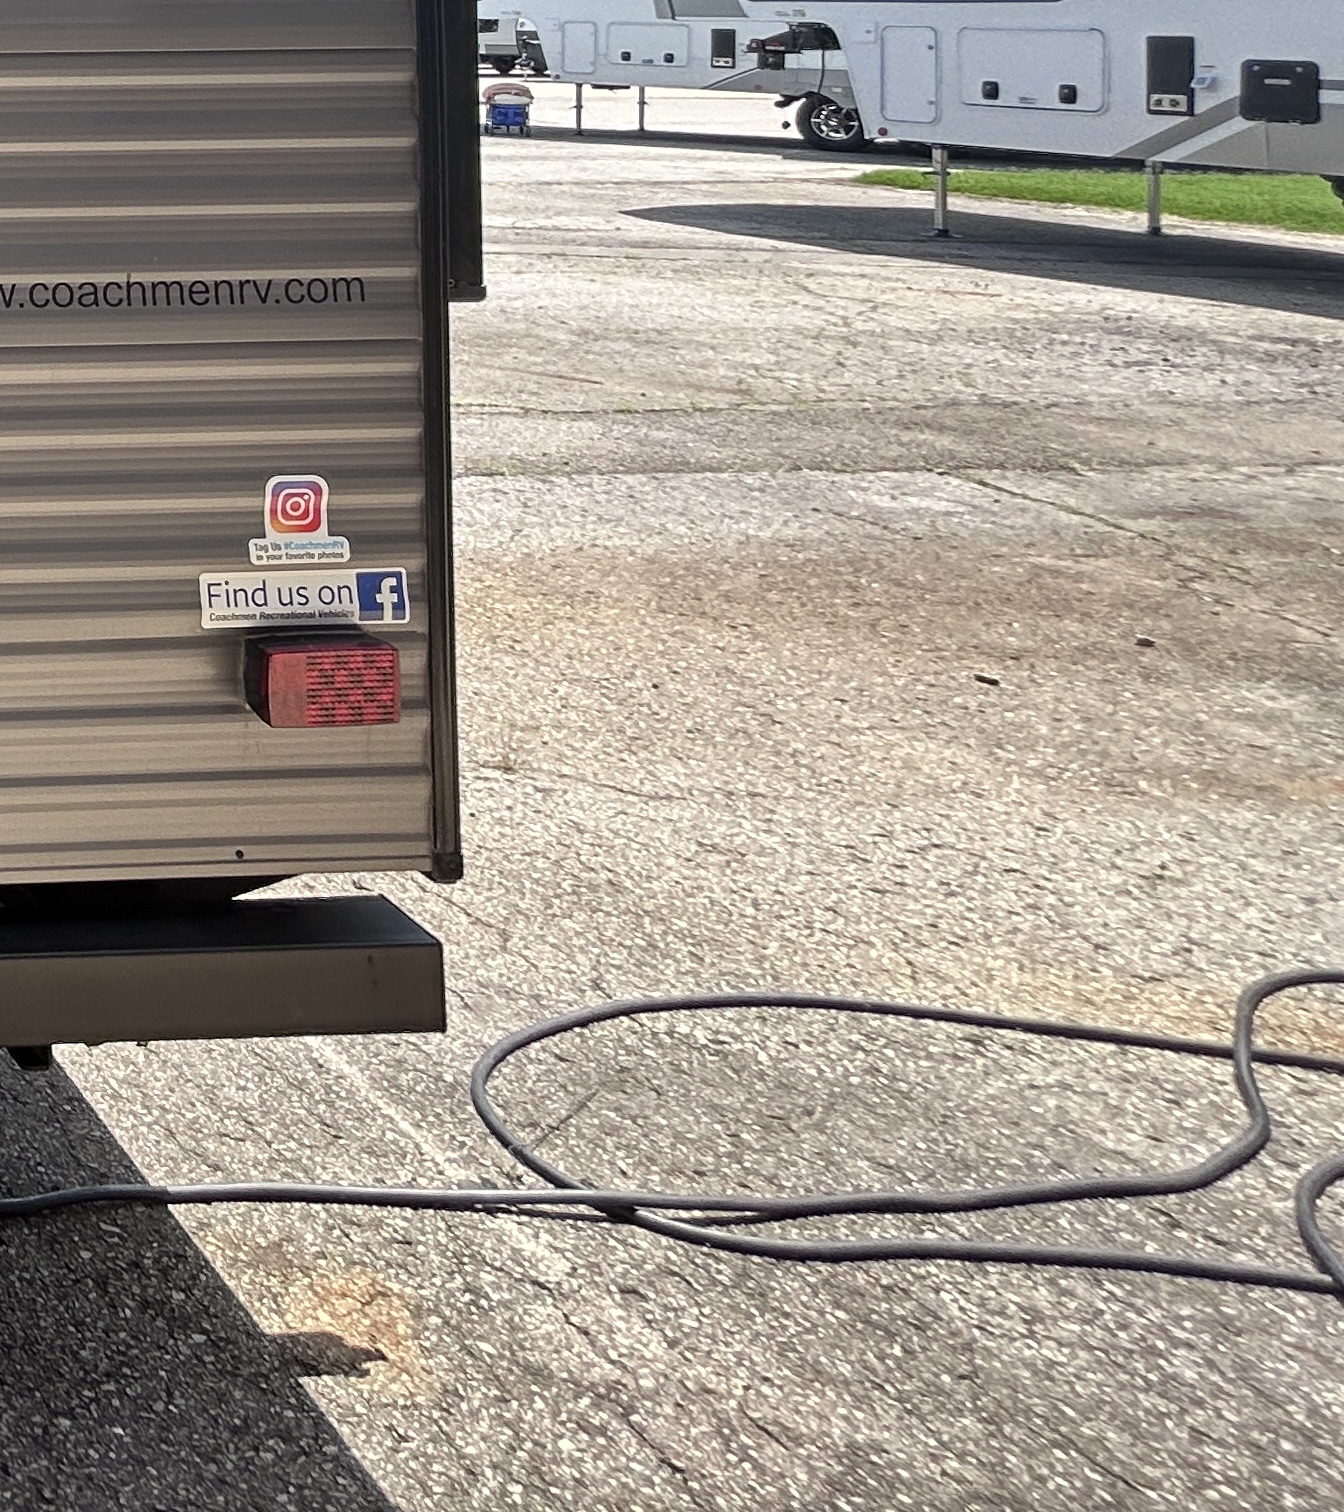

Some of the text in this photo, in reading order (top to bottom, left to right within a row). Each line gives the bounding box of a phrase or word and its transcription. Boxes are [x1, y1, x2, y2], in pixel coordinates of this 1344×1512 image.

[253, 542, 269, 553] Tag
[270, 541, 282, 551] Us
[207, 579, 268, 609] Find
[276, 583, 310, 607] us
[318, 583, 354, 605] on
[209, 611, 257, 622] Coachmen
[259, 609, 316, 621] Recreational
